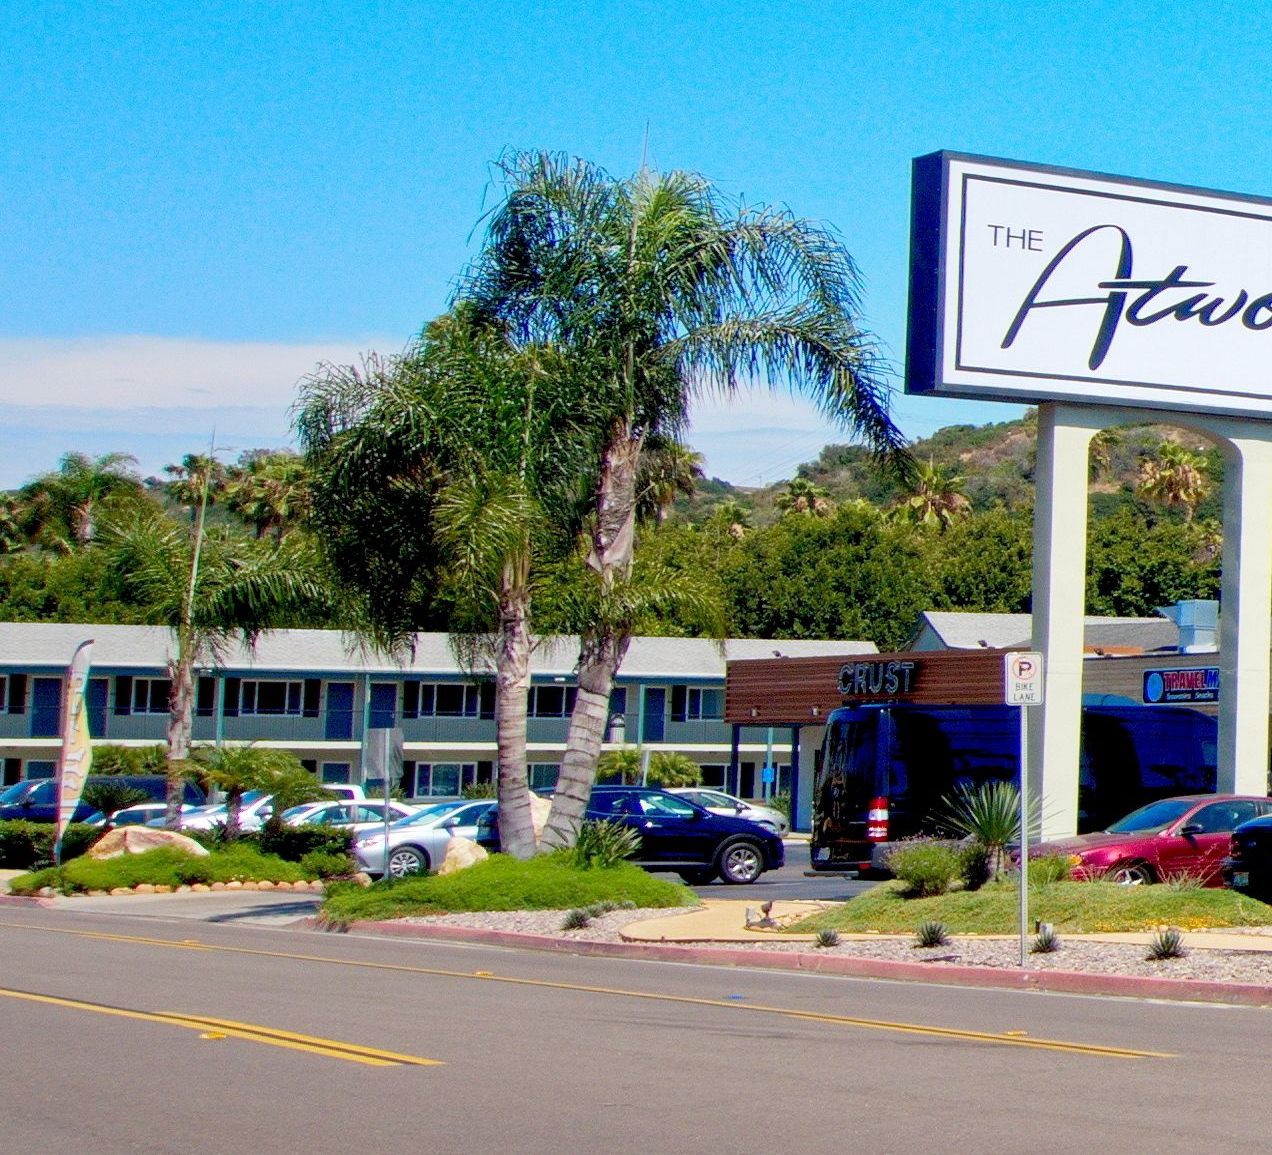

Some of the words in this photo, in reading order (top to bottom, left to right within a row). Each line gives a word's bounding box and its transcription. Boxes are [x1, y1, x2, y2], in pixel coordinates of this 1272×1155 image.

[988, 225, 1044, 252] THE
[836, 660, 915, 694] CRUST
[1015, 682, 1034, 691] BIKE
[1013, 692, 1036, 702] LANE
